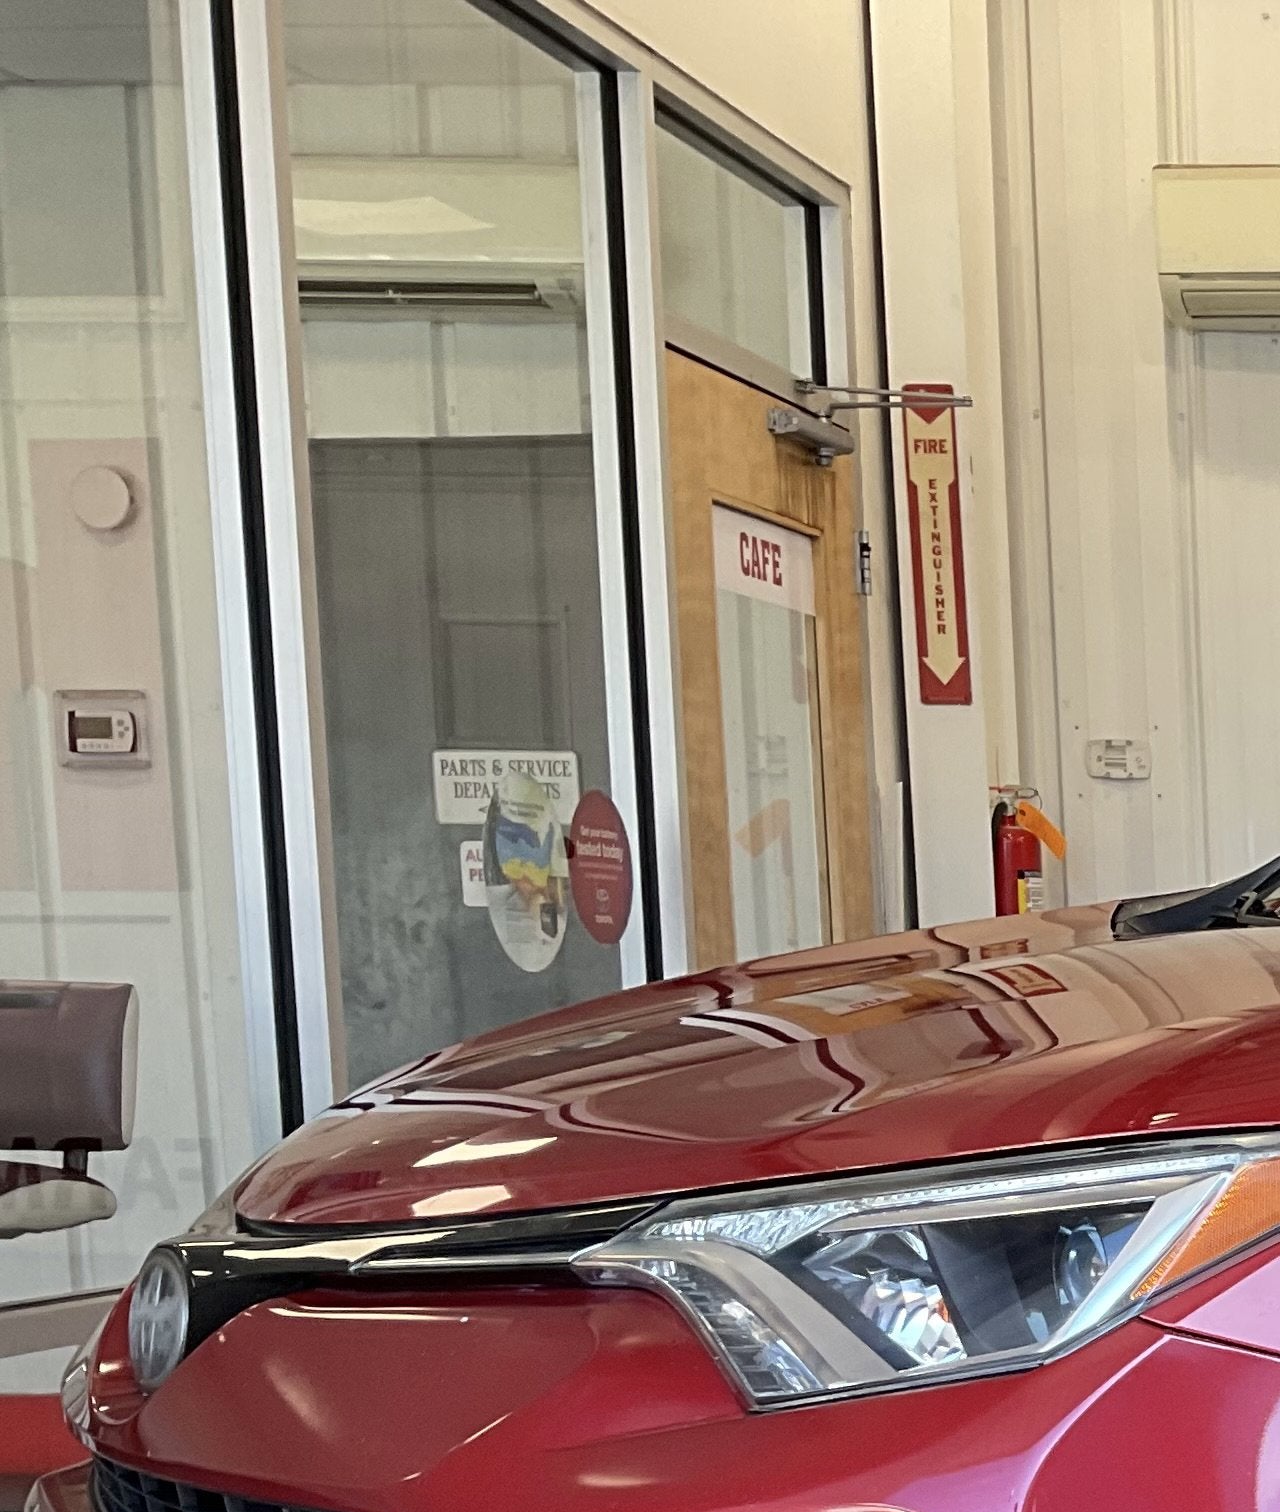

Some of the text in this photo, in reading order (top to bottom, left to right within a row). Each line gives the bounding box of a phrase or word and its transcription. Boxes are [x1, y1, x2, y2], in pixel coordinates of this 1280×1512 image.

[913, 438, 948, 455] FIRE
[739, 531, 783, 587] CAFE
[928, 478, 947, 635] EXTINGUISHER
[440, 758, 572, 778] PARTS & SERVICE
